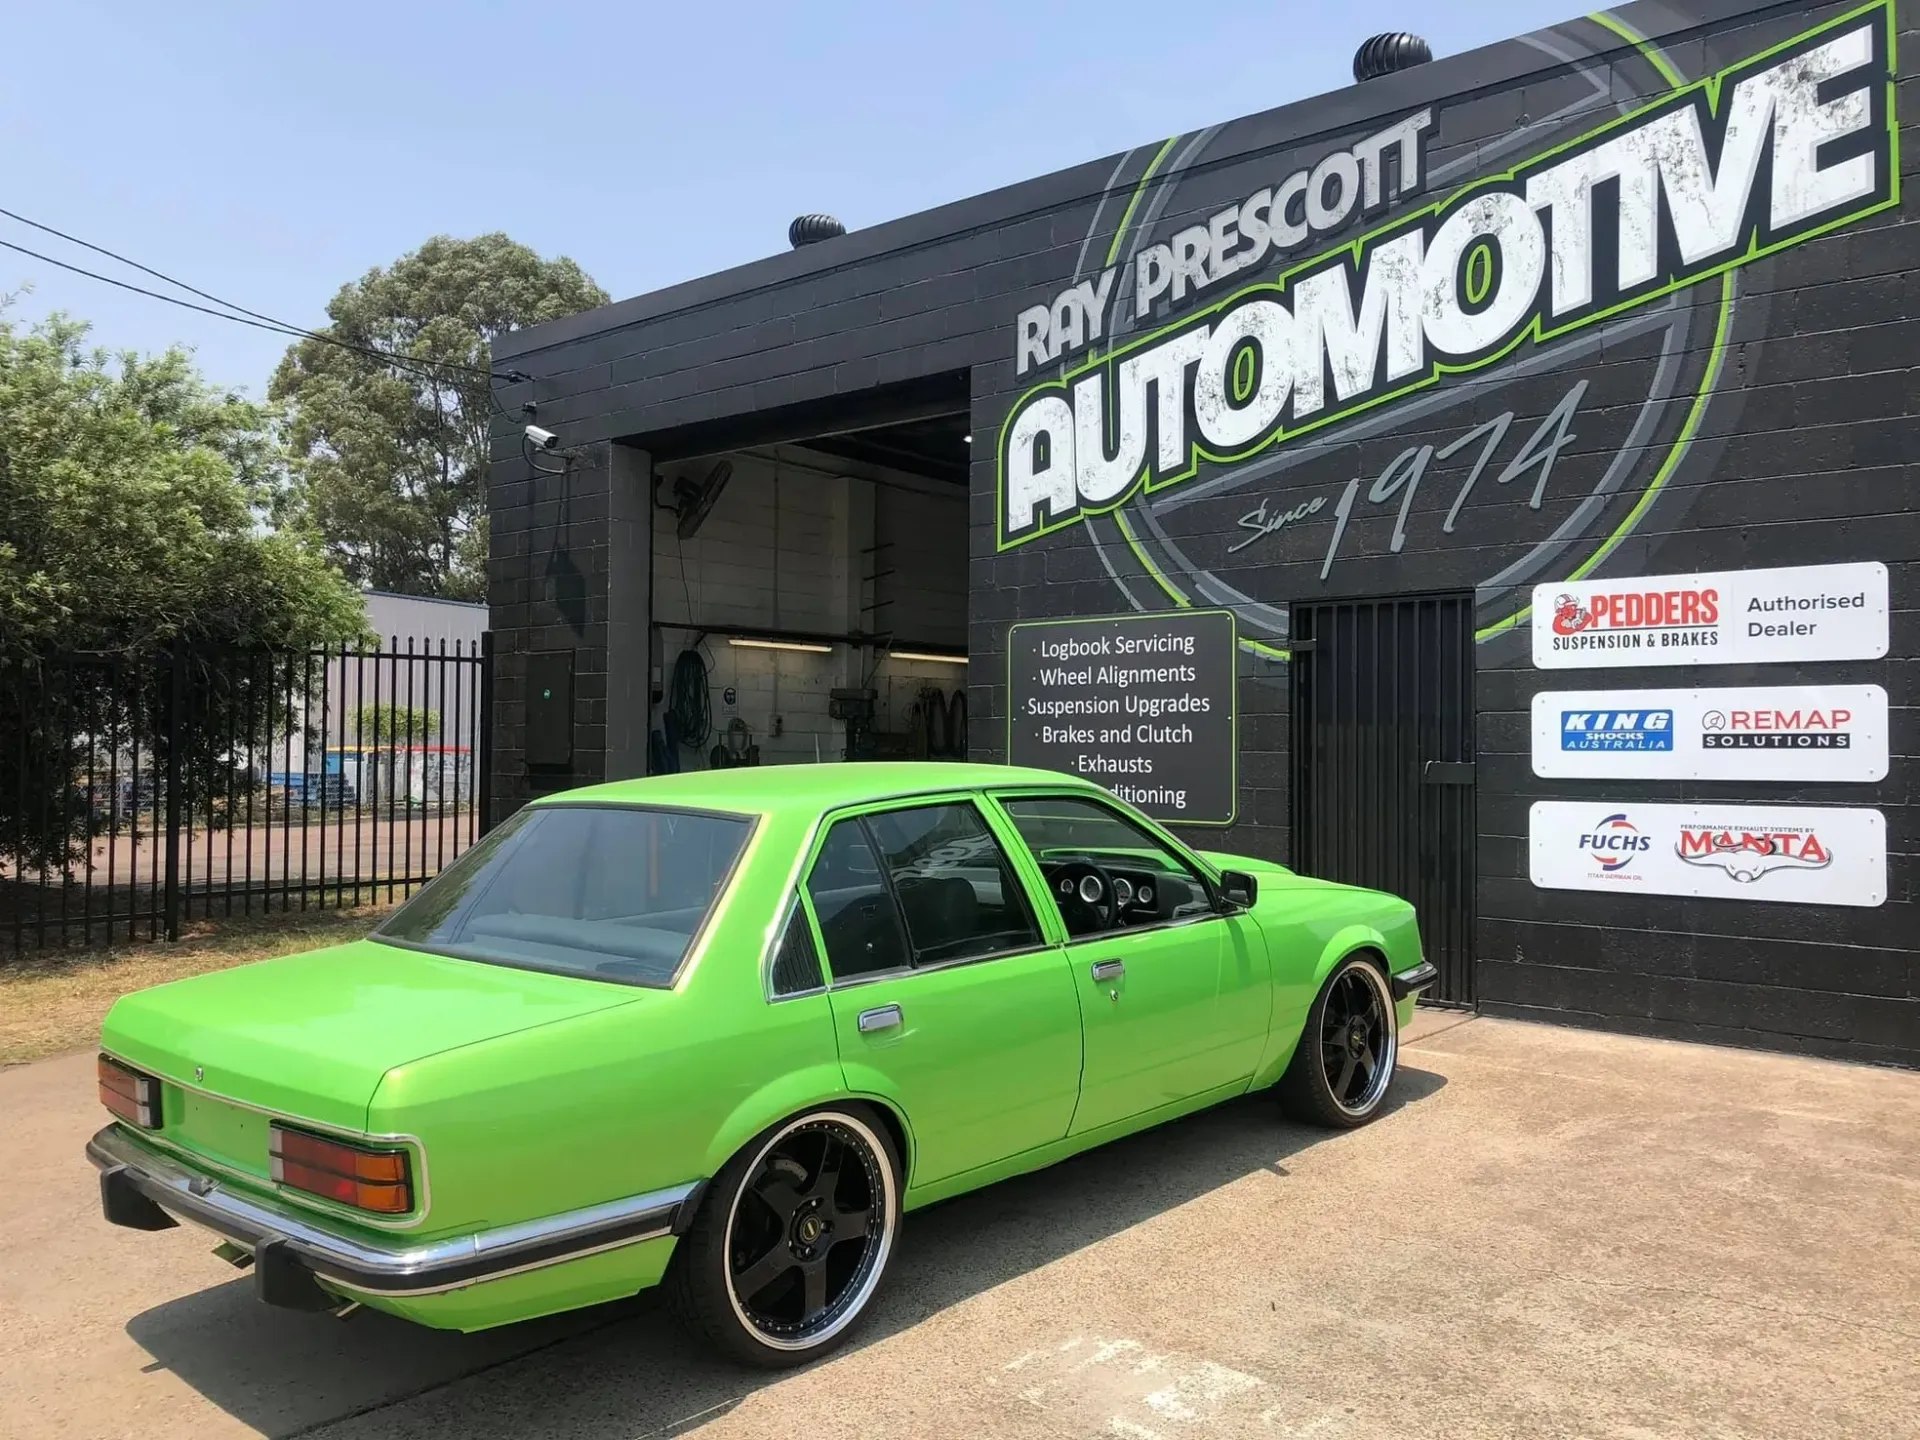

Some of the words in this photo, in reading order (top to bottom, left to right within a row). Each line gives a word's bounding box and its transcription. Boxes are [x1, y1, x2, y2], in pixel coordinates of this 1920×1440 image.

[1017, 266, 1116, 375] RAY
[1136, 107, 1431, 319] PRESCOTT
[1007, 24, 1875, 533] AUTOMOTIVE
[1228, 497, 1327, 552] Since
[1320, 379, 1589, 580] 1974
[1590, 589, 1719, 628] PEDDERS
[1747, 593, 1865, 613] Authorised
[1748, 621, 1817, 638] Dealer
[1041, 637, 1110, 661] Logbook
[1115, 633, 1195, 655] Servicing
[1553, 633, 1641, 651] SUSPENSION
[1647, 634, 1656, 648] &
[1661, 631, 1719, 648] BRAKES
[1040, 669, 1092, 686] Wheel
[1097, 664, 1196, 688] Alignments
[1027, 696, 1119, 718] Suspension
[1125, 693, 1210, 717] Upgrades
[1564, 712, 1670, 730] KING
[1731, 710, 1851, 729] REMAP
[1042, 725, 1095, 743] Brakes
[1100, 724, 1131, 743] and
[1136, 724, 1193, 743] Clutch
[1585, 732, 1645, 740] SHOCKS
[1705, 735, 1848, 747] SOLUTIONS
[1566, 740, 1665, 749] AUSTRALIA
[1078, 754, 1153, 773] Exhausts
[1110, 784, 1187, 809] ditioning
[1579, 834, 1651, 851] FUCHS
[1680, 830, 1827, 861] MANTA
